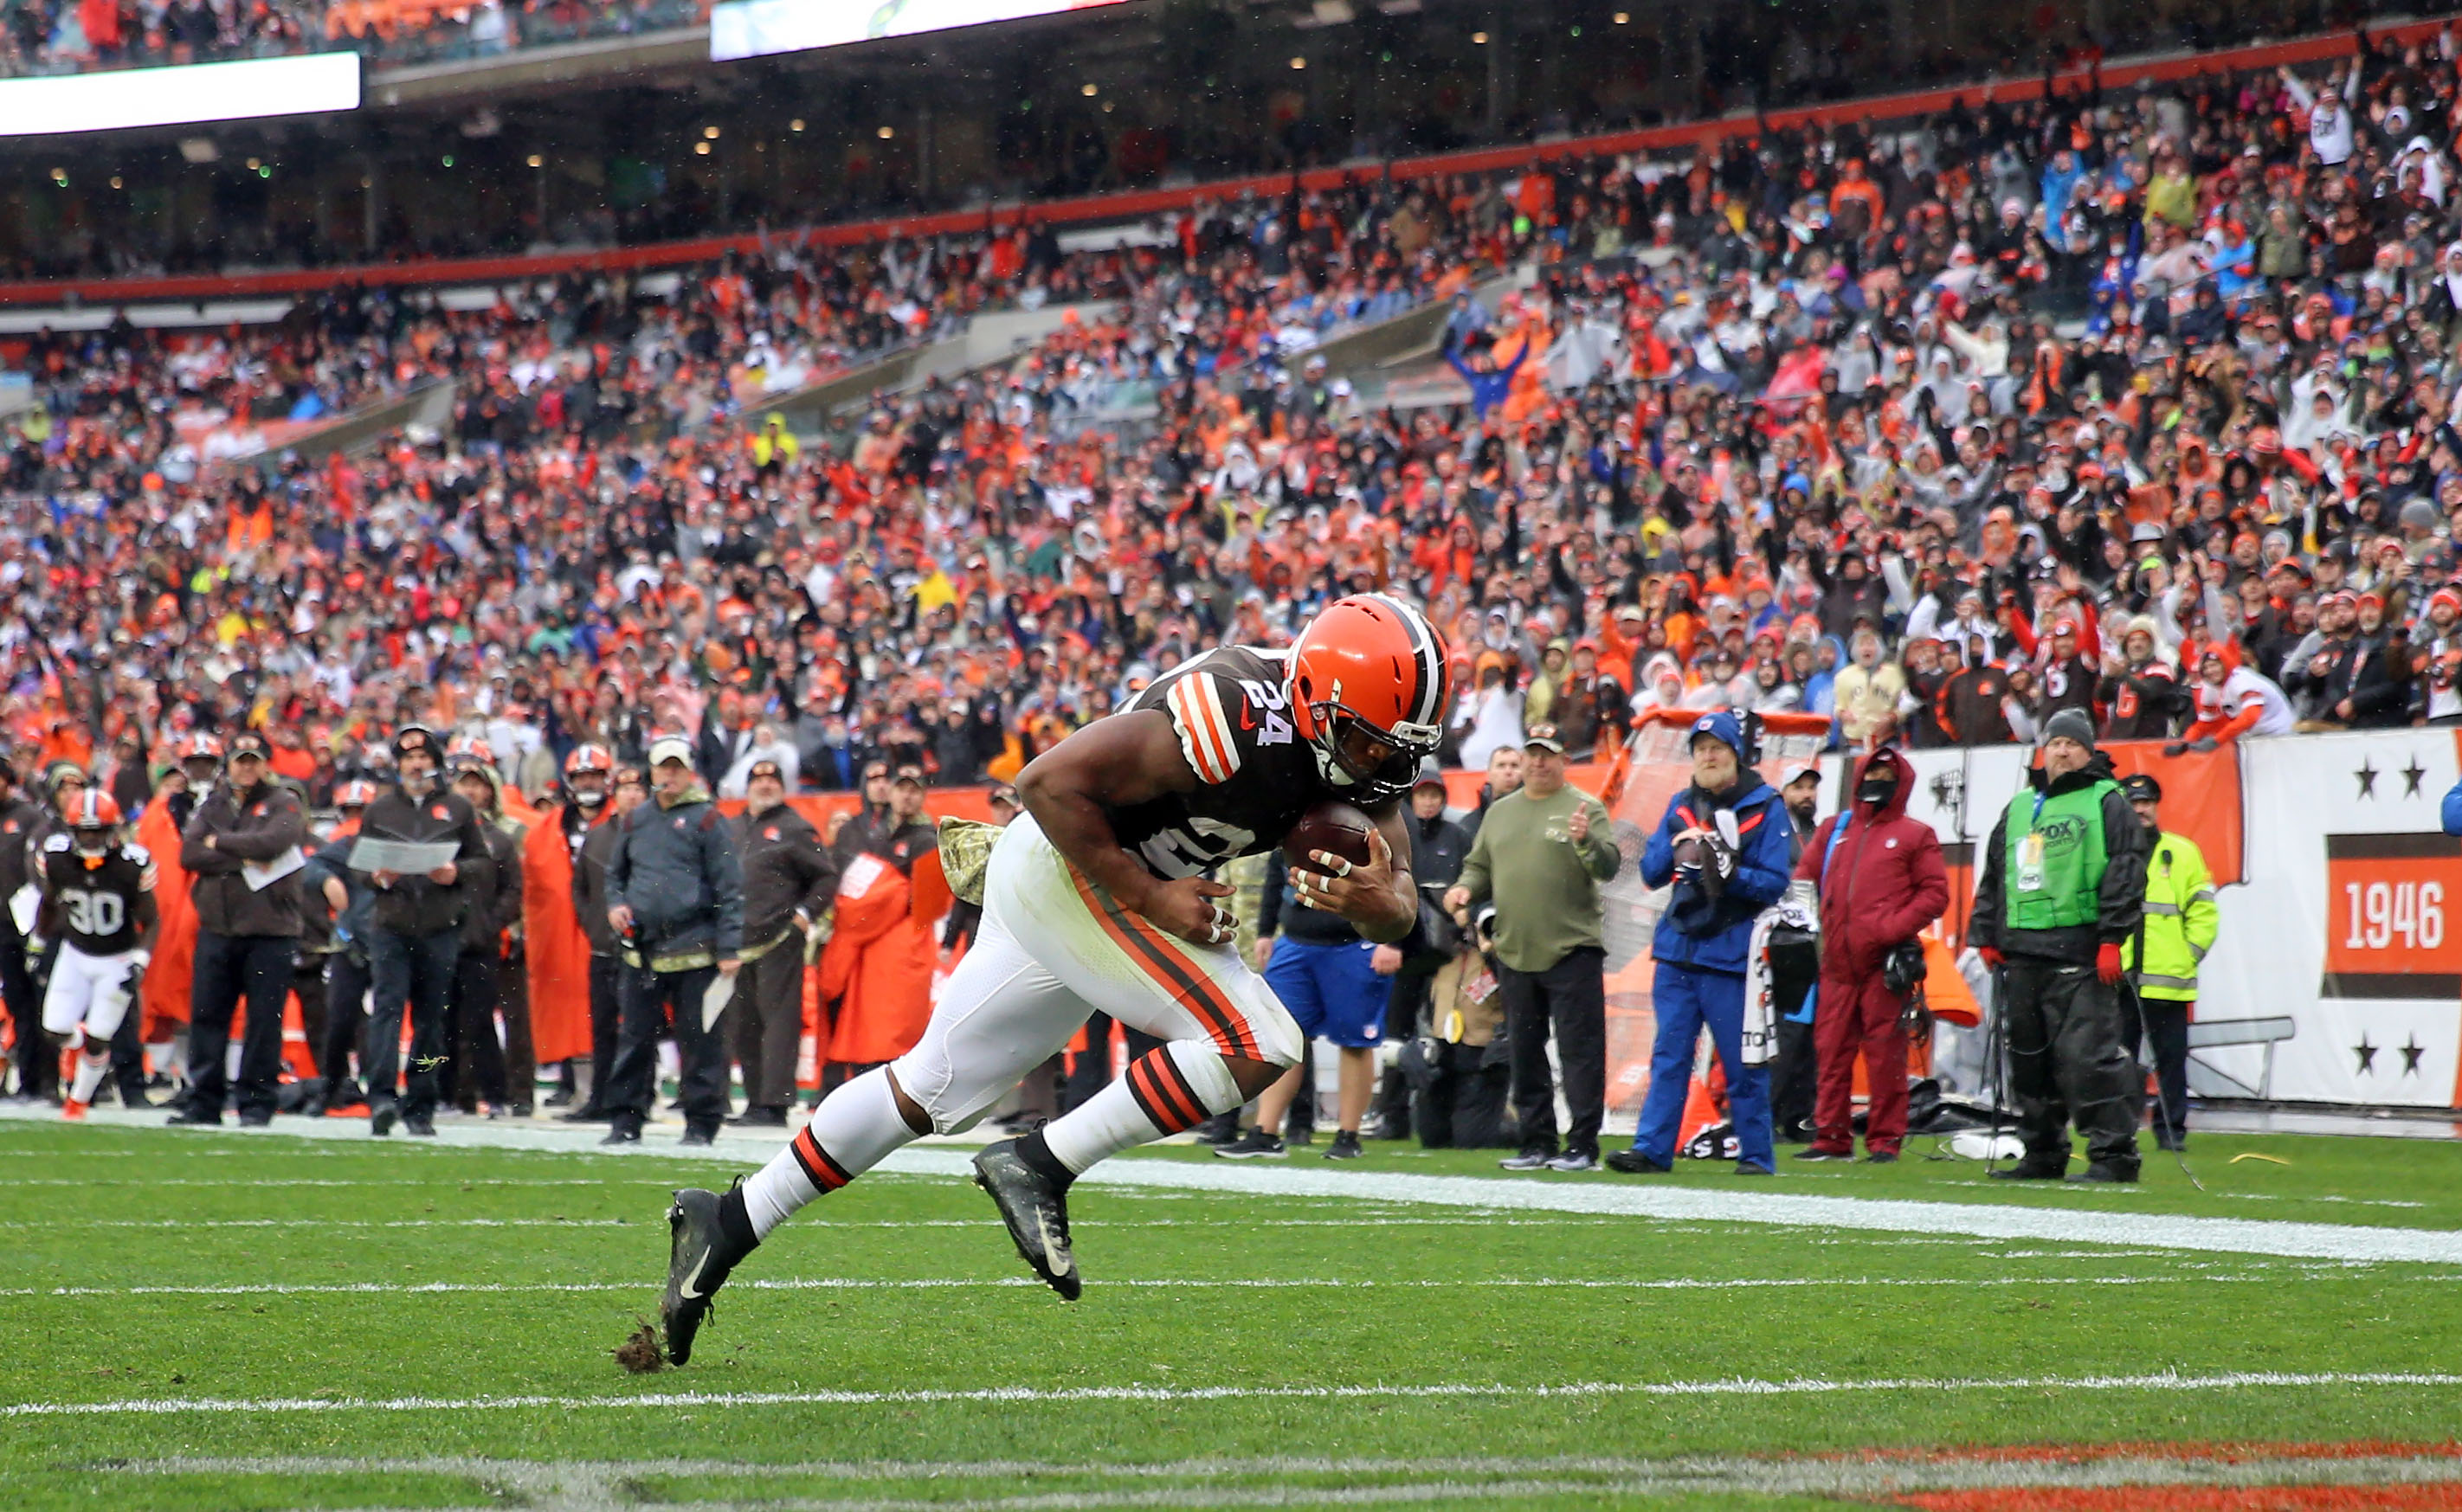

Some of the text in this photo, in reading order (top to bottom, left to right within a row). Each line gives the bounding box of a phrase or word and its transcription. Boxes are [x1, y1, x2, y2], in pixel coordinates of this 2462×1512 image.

[1238, 679, 1293, 746] 24
[57, 888, 124, 936] 30
[2346, 881, 2444, 949] 1946
